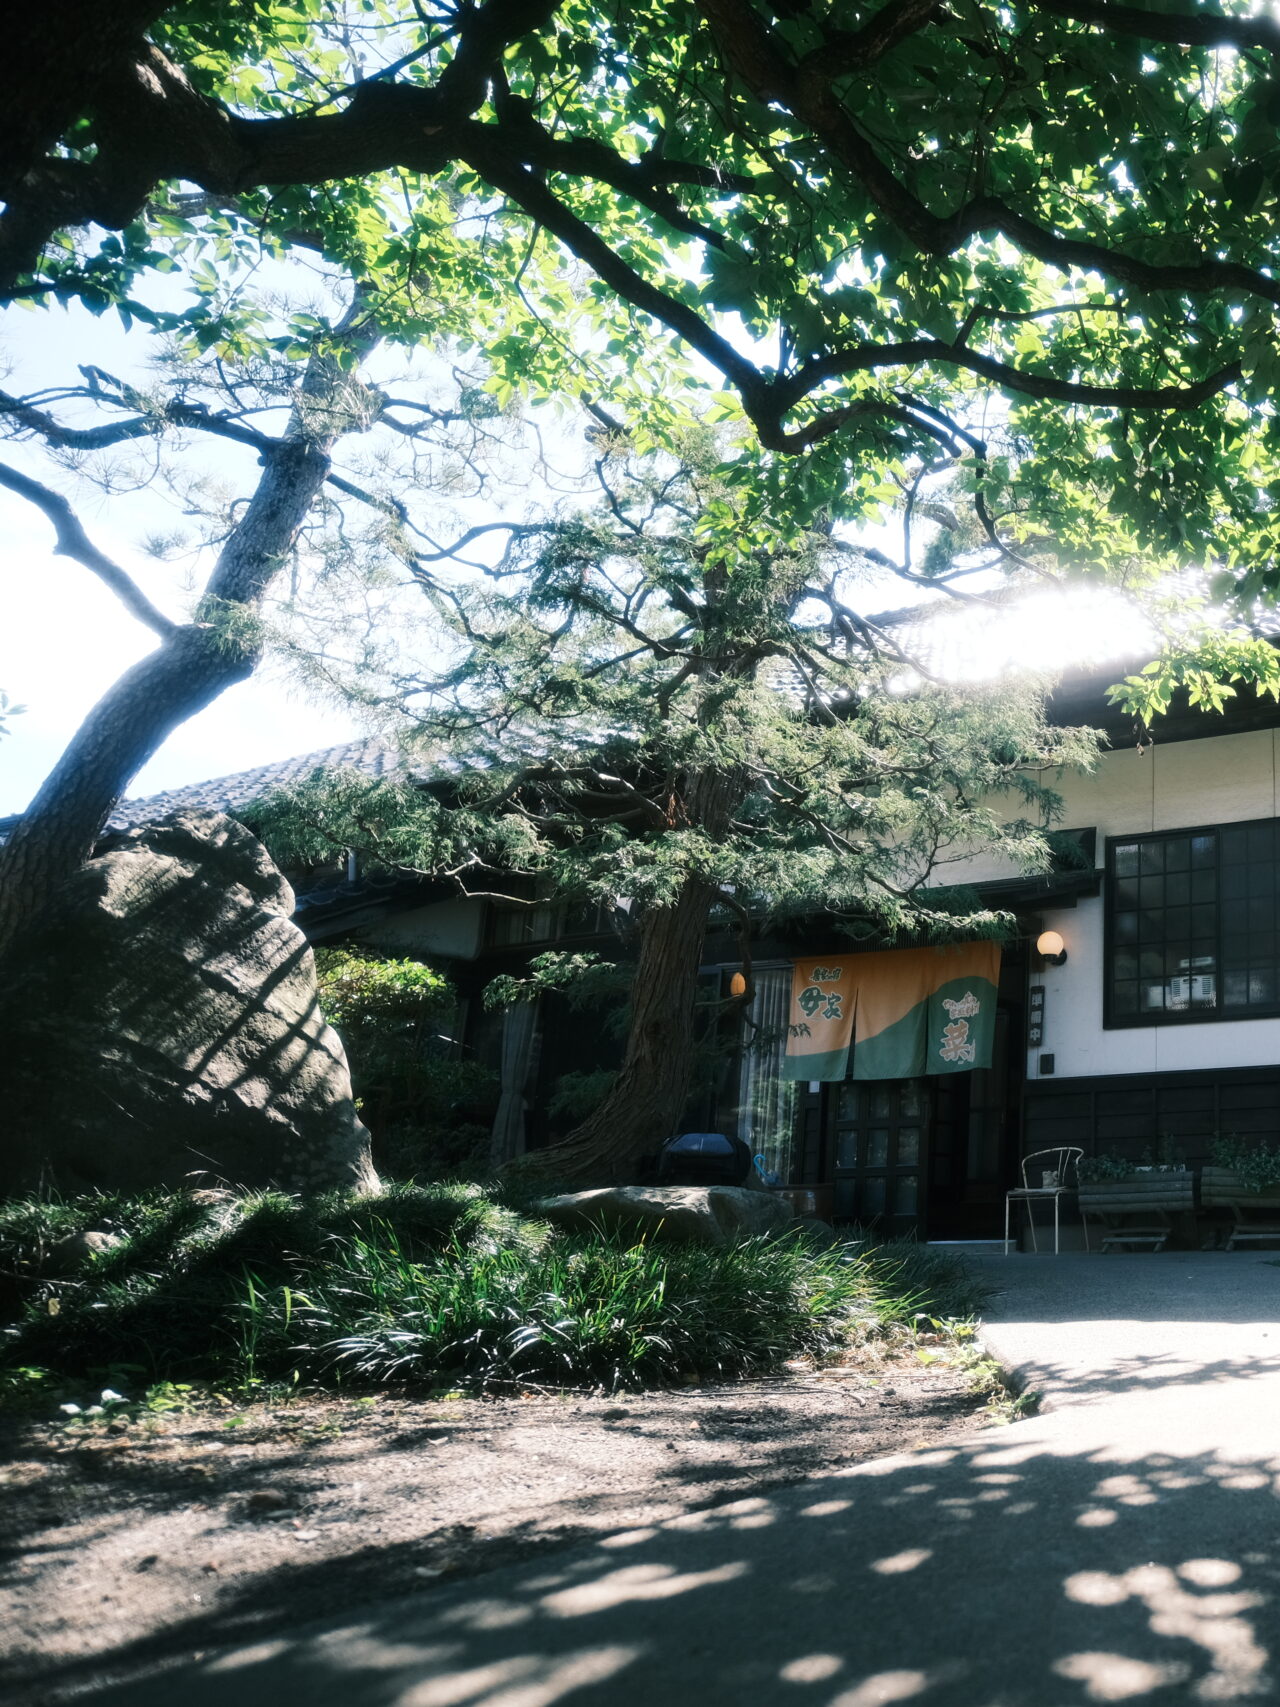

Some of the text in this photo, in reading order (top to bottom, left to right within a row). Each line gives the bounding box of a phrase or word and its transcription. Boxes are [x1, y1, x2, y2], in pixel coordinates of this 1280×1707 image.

[798, 985, 843, 1020] 母家
[1030, 993, 1043, 1041] 準備中
